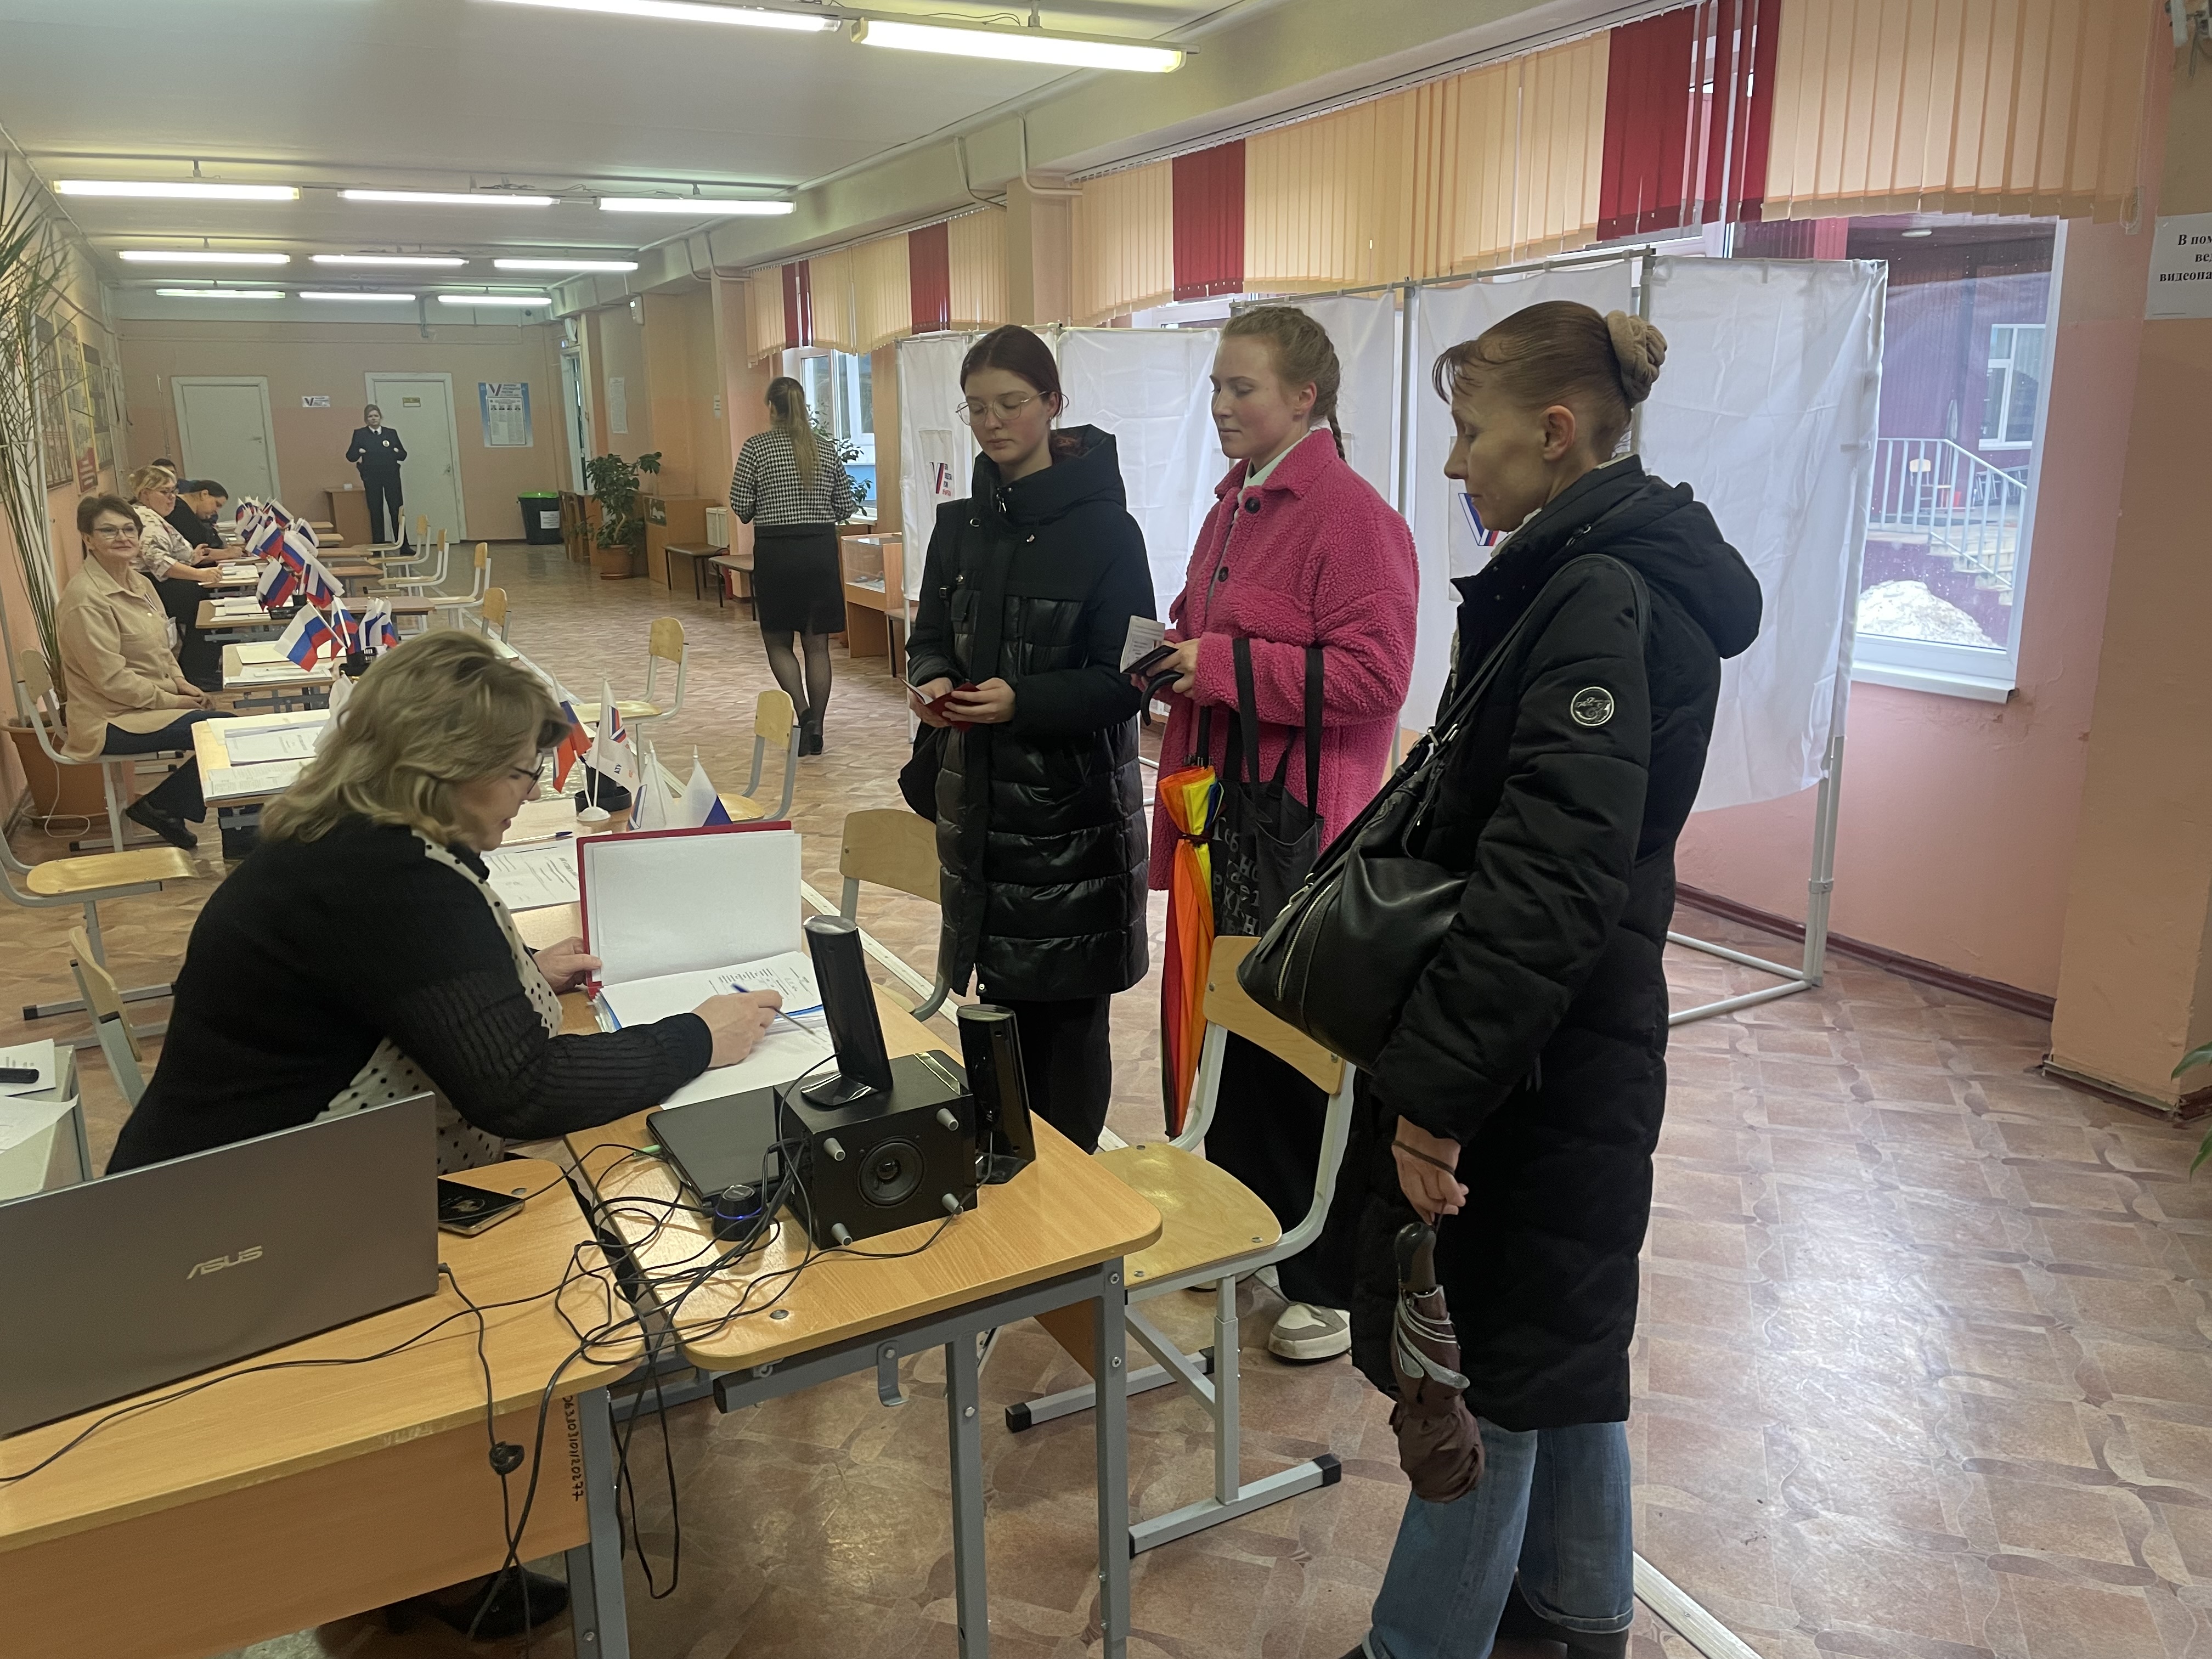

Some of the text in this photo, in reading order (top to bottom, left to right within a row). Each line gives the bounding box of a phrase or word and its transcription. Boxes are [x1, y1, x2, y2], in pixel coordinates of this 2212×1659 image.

[2177, 234, 2187, 246] В
[2195, 253, 2212, 262] ве
[186, 1245, 263, 1280] ASUS
